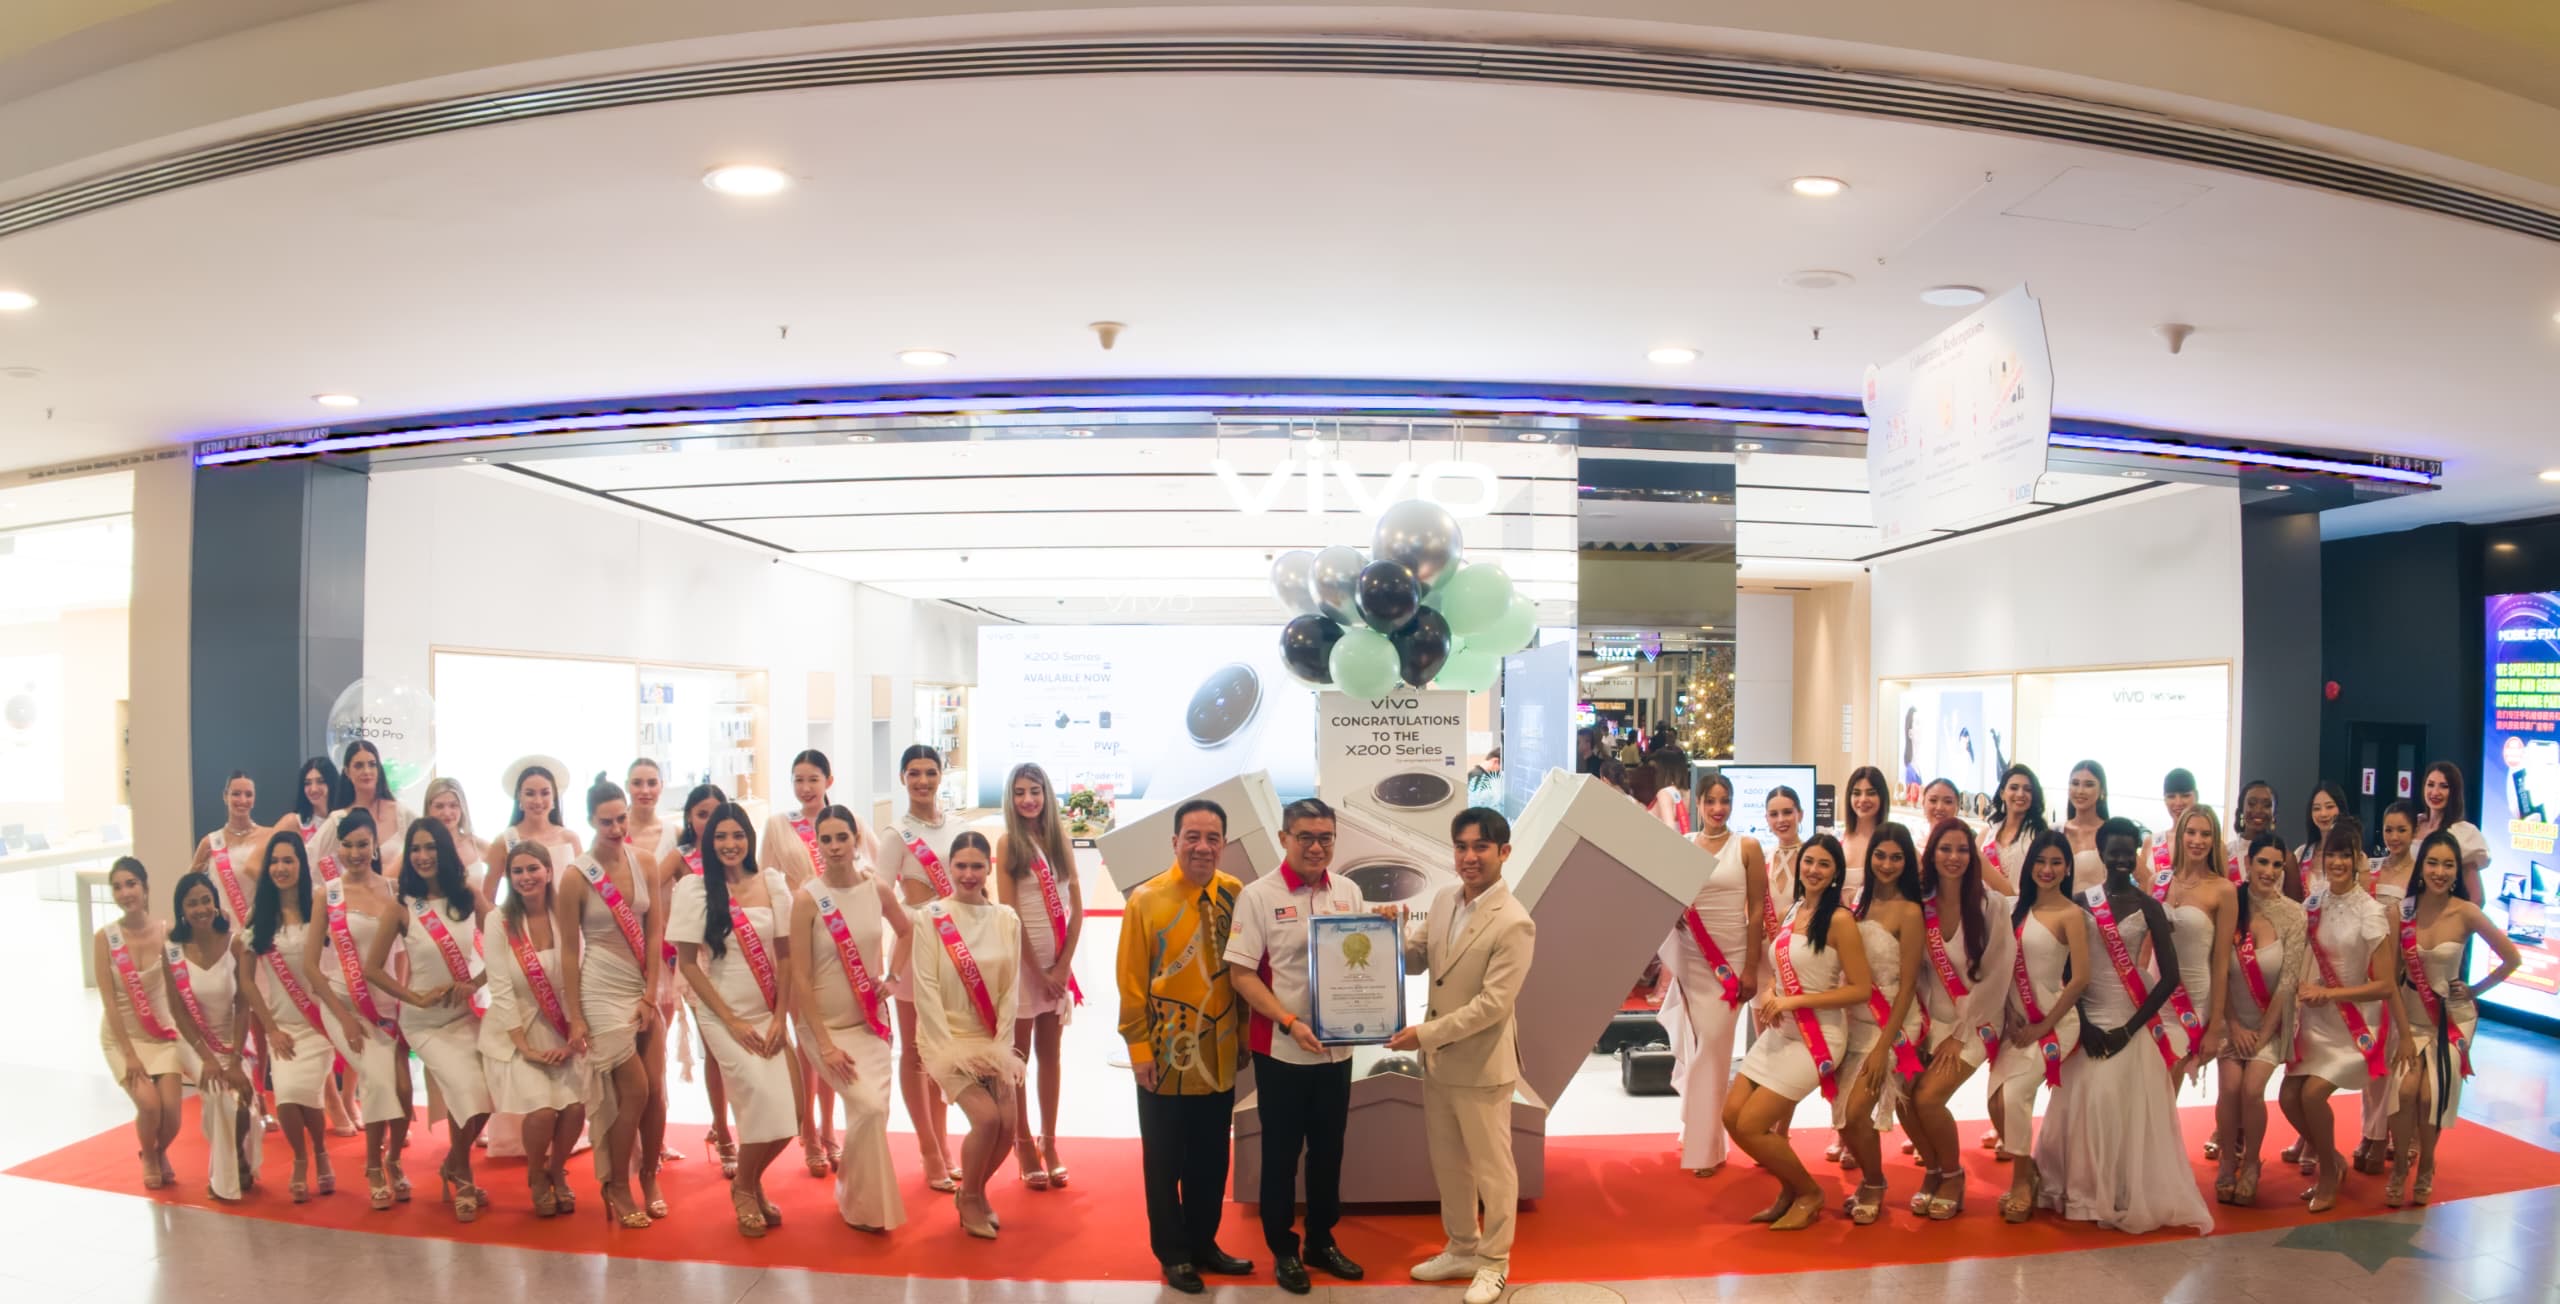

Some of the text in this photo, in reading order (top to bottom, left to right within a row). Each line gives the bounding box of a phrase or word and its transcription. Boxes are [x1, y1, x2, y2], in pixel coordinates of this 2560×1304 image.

[1211, 437, 1499, 518] vivo
[1024, 673, 1111, 683] AVAILABLE NOW
[2112, 687, 2145, 703] vivo
[359, 713, 393, 725] vivo
[1331, 715, 1460, 727] CONGRATULATIONS
[1371, 695, 1419, 709] vivo
[347, 727, 404, 740] X200 Pro
[1345, 743, 1443, 756] X200 Series
[1372, 731, 1420, 742] TO THE
[930, 860, 951, 895] CROA
[1040, 867, 1063, 918] CYPRUS
[616, 899, 641, 937] NORTH
[336, 929, 369, 1002] MONGOLIA
[522, 943, 541, 972] NEW
[843, 938, 872, 994] POLAND
[952, 940, 982, 990] RUSSIA
[1781, 945, 1800, 995] SERBIA
[1927, 927, 1957, 982] SWEDEN
[2103, 923, 2133, 975] UGANDA
[127, 970, 151, 1018] MACAO
[270, 951, 312, 1010] MALAYSIA
[2406, 944, 2435, 1002] VIETNAM
